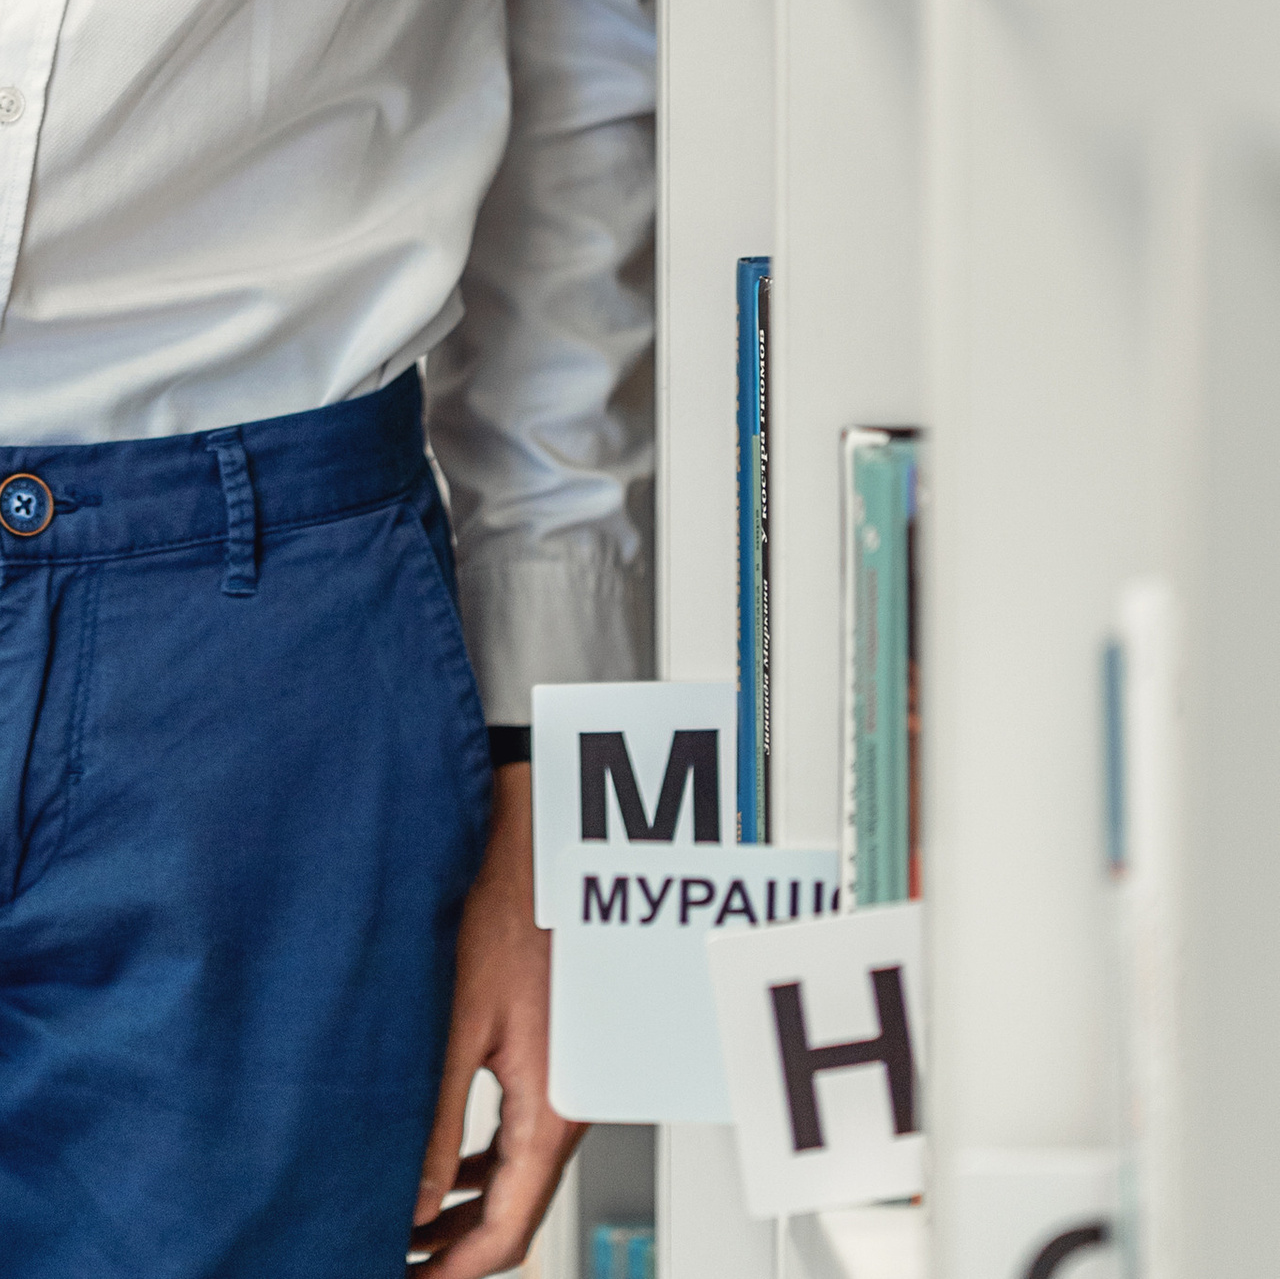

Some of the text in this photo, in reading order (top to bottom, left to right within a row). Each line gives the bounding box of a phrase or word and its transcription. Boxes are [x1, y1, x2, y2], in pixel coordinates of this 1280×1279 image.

[579, 729, 720, 843] М
[583, 876, 840, 926] МУРАШ
[768, 965, 921, 1152] Н
